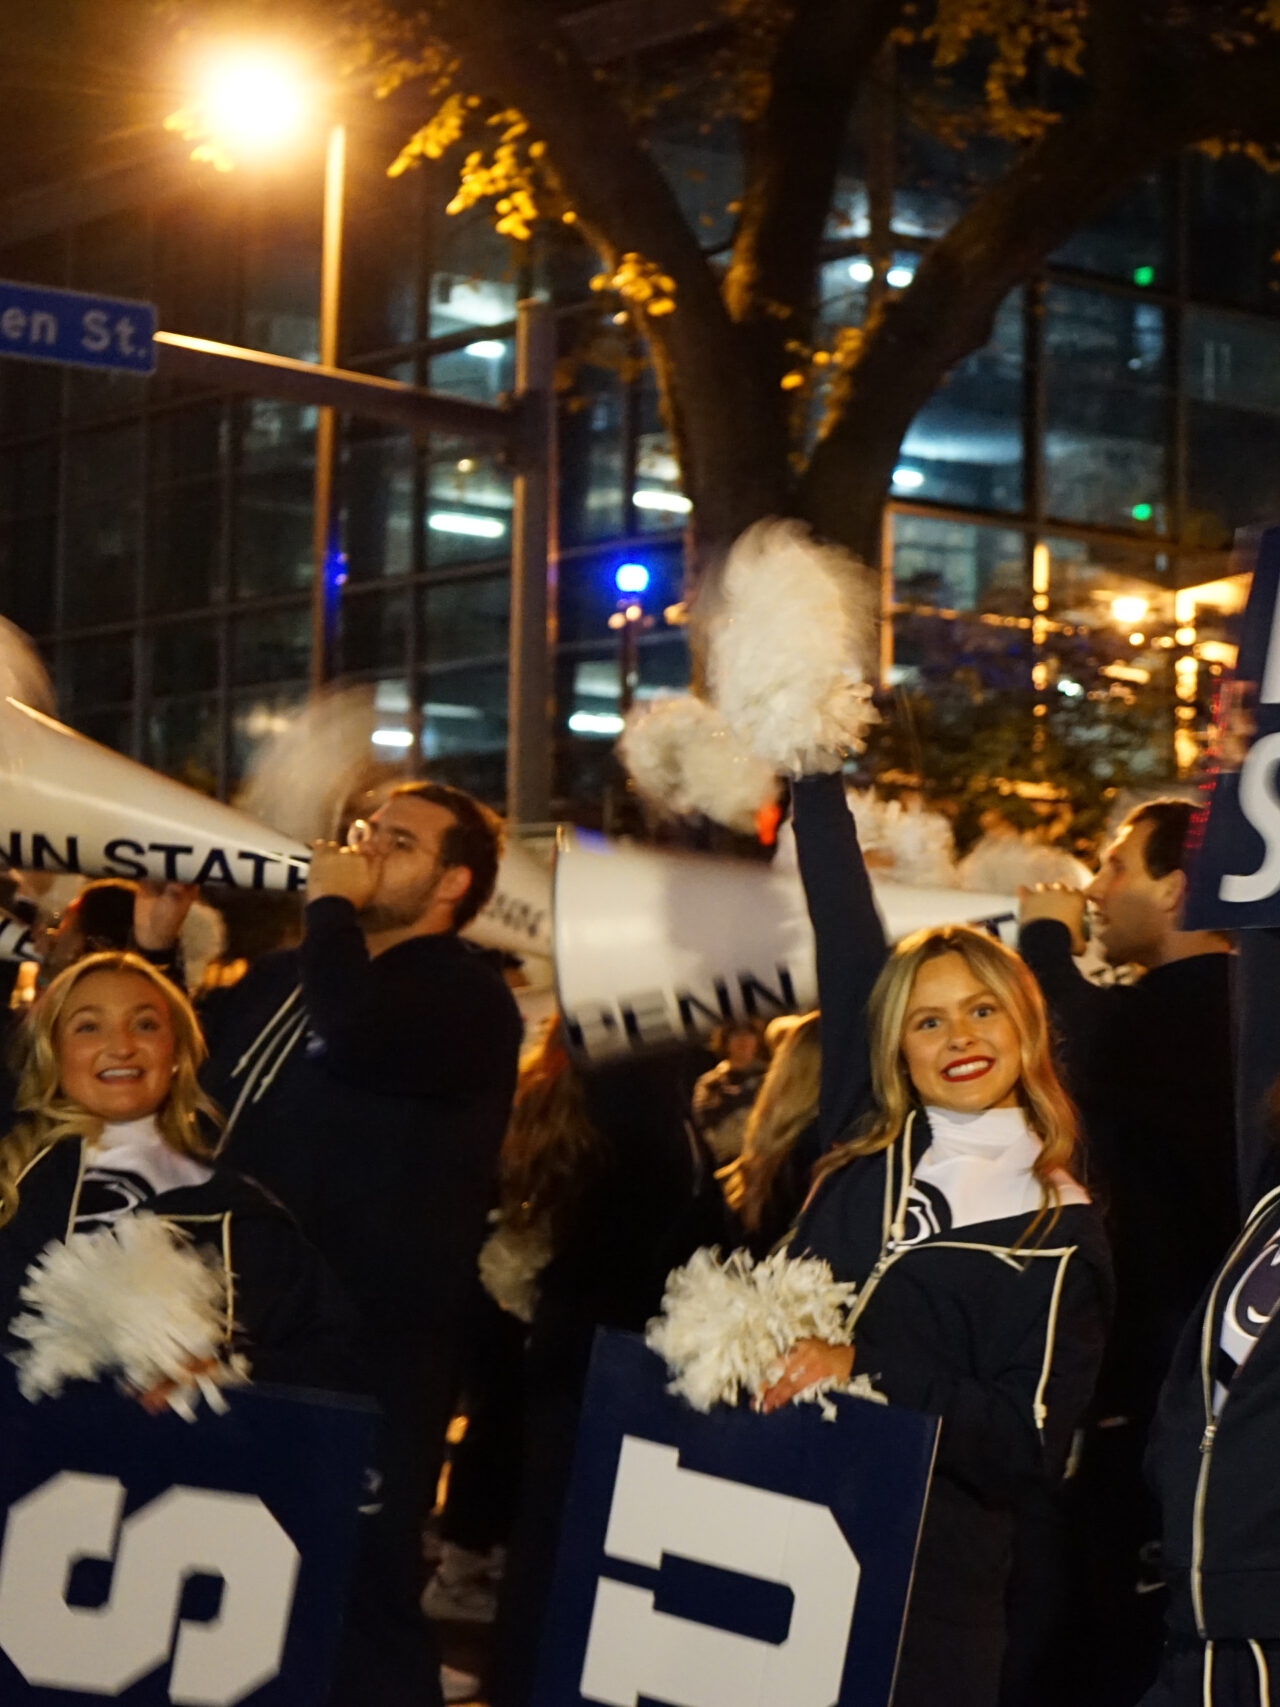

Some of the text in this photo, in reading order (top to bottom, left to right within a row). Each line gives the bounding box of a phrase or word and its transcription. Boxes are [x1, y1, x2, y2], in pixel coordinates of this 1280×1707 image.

[1, 306, 147, 358] en St.
[0, 1469, 302, 1707] S
